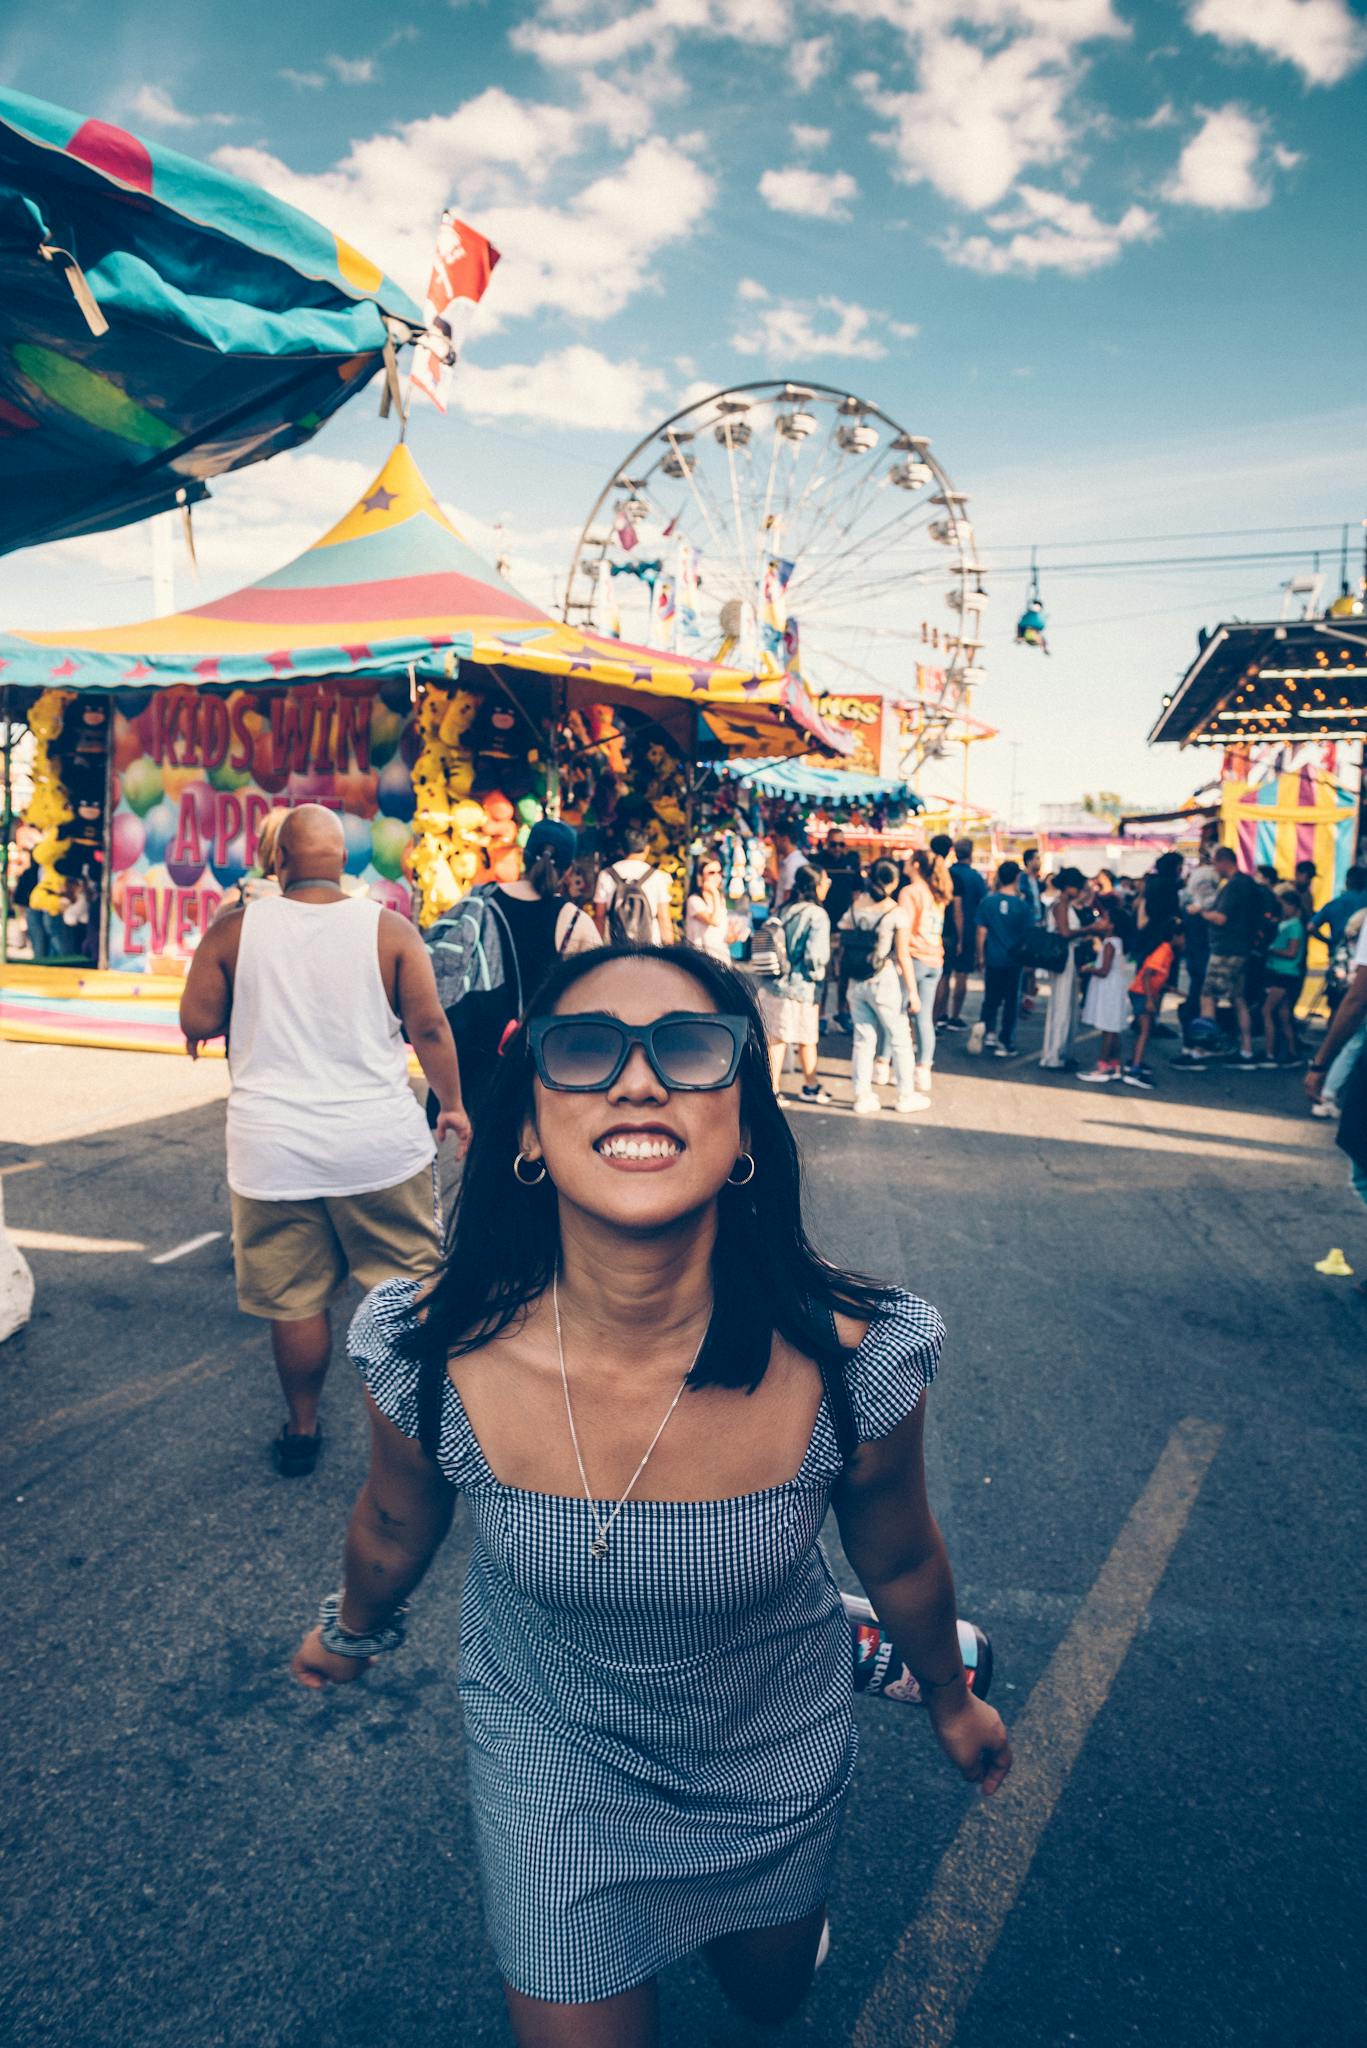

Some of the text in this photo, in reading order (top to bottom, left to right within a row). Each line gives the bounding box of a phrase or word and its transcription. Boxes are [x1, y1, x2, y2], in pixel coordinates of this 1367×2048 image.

[153, 692, 374, 775] KIDS WIN
[174, 792, 202, 863] A
